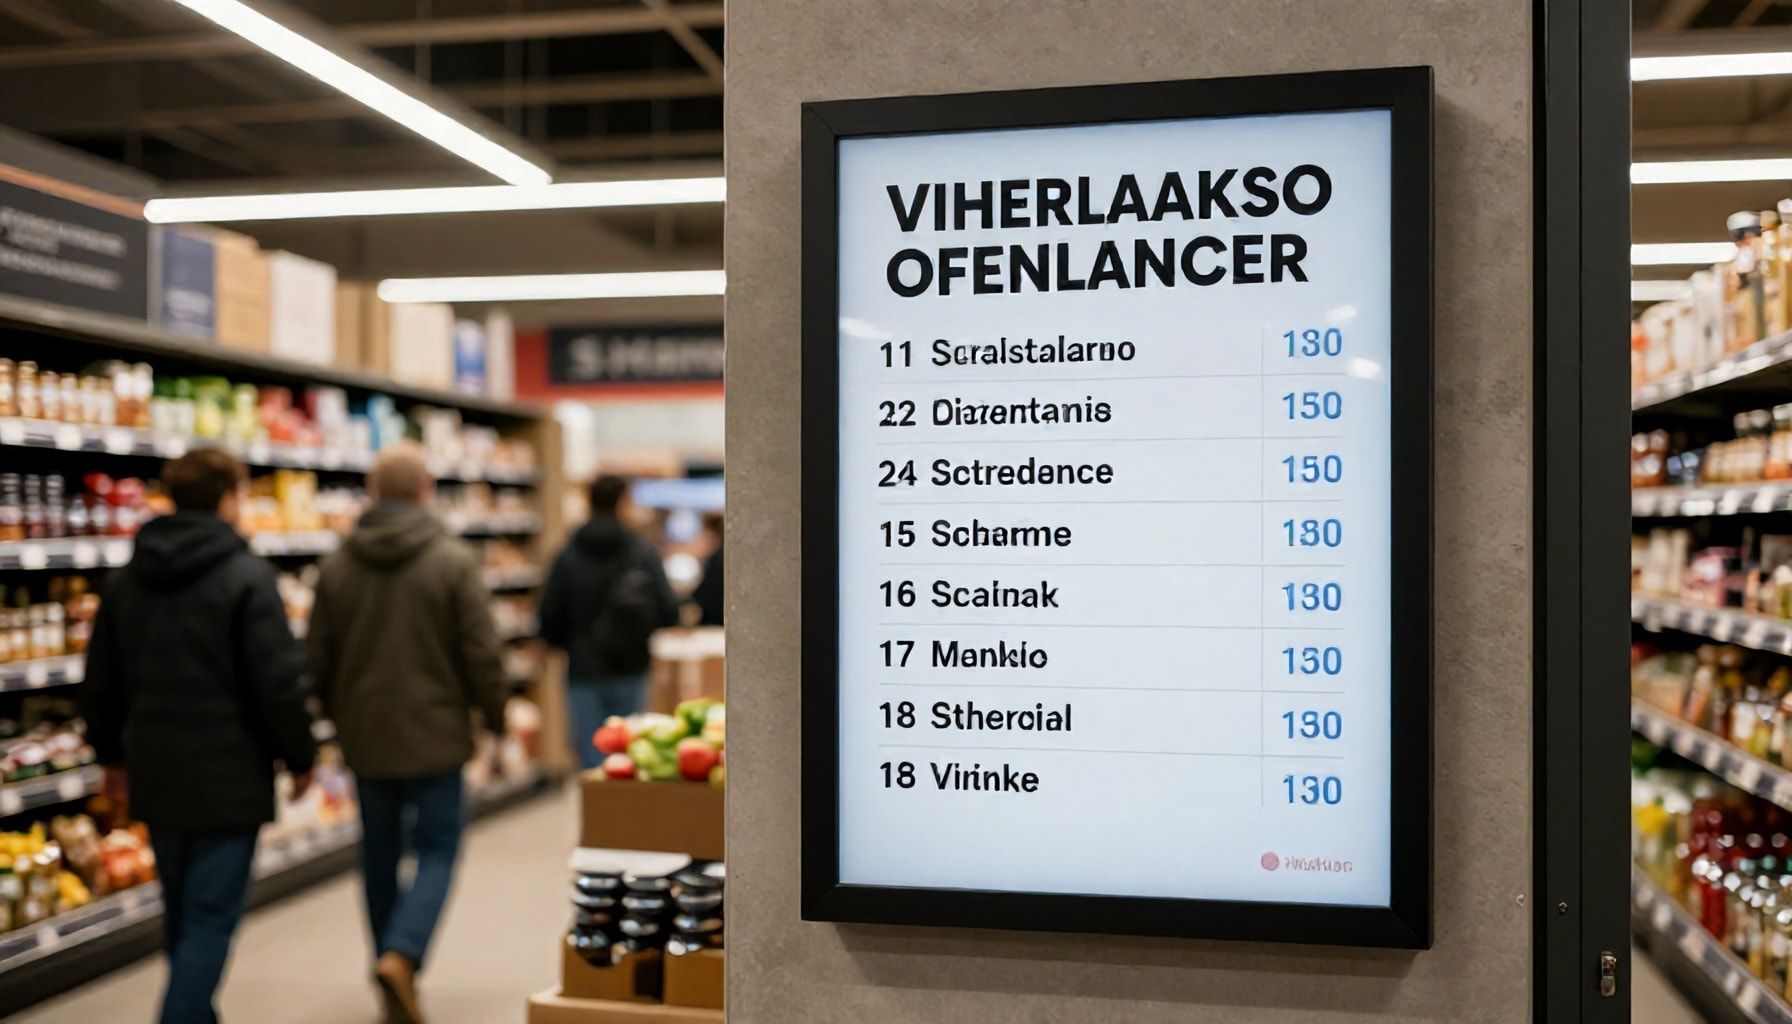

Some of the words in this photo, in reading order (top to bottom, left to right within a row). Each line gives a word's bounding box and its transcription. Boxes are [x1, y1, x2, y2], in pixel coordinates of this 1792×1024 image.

[886, 163, 1333, 233] VIHERLAAKSO
[886, 233, 1309, 298] OFENLANCER
[881, 341, 911, 367] 11
[879, 400, 916, 427] 22
[1282, 391, 1342, 420] 150
[878, 460, 917, 487] 24
[1282, 455, 1342, 483] 150
[880, 520, 916, 547] 15
[880, 580, 916, 607] 16
[880, 640, 915, 667] 17
[879, 701, 916, 728] 18
[880, 761, 916, 789] 18
[1283, 774, 1342, 805] 130
